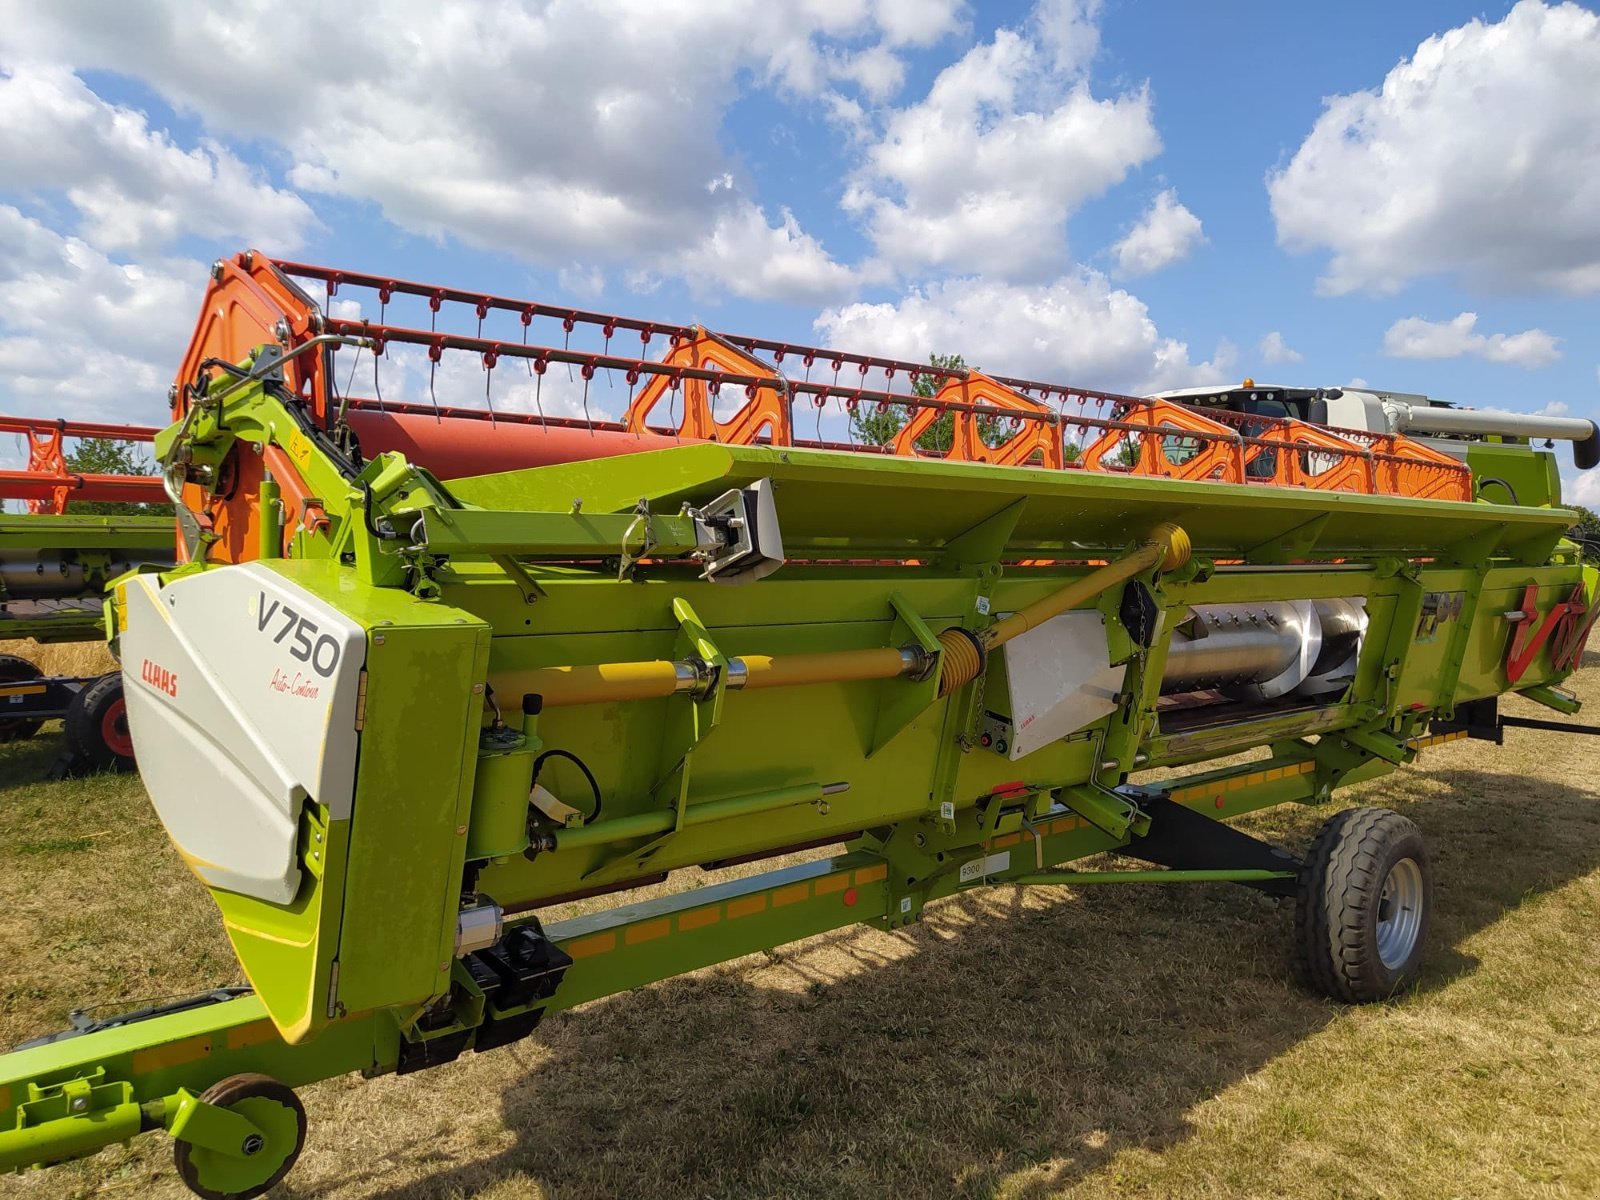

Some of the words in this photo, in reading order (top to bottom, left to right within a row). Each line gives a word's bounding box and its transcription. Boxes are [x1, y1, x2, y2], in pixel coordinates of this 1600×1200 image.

[257, 591, 341, 679] V750
[141, 658, 178, 699] CLAAS
[962, 863, 981, 877] 9300
